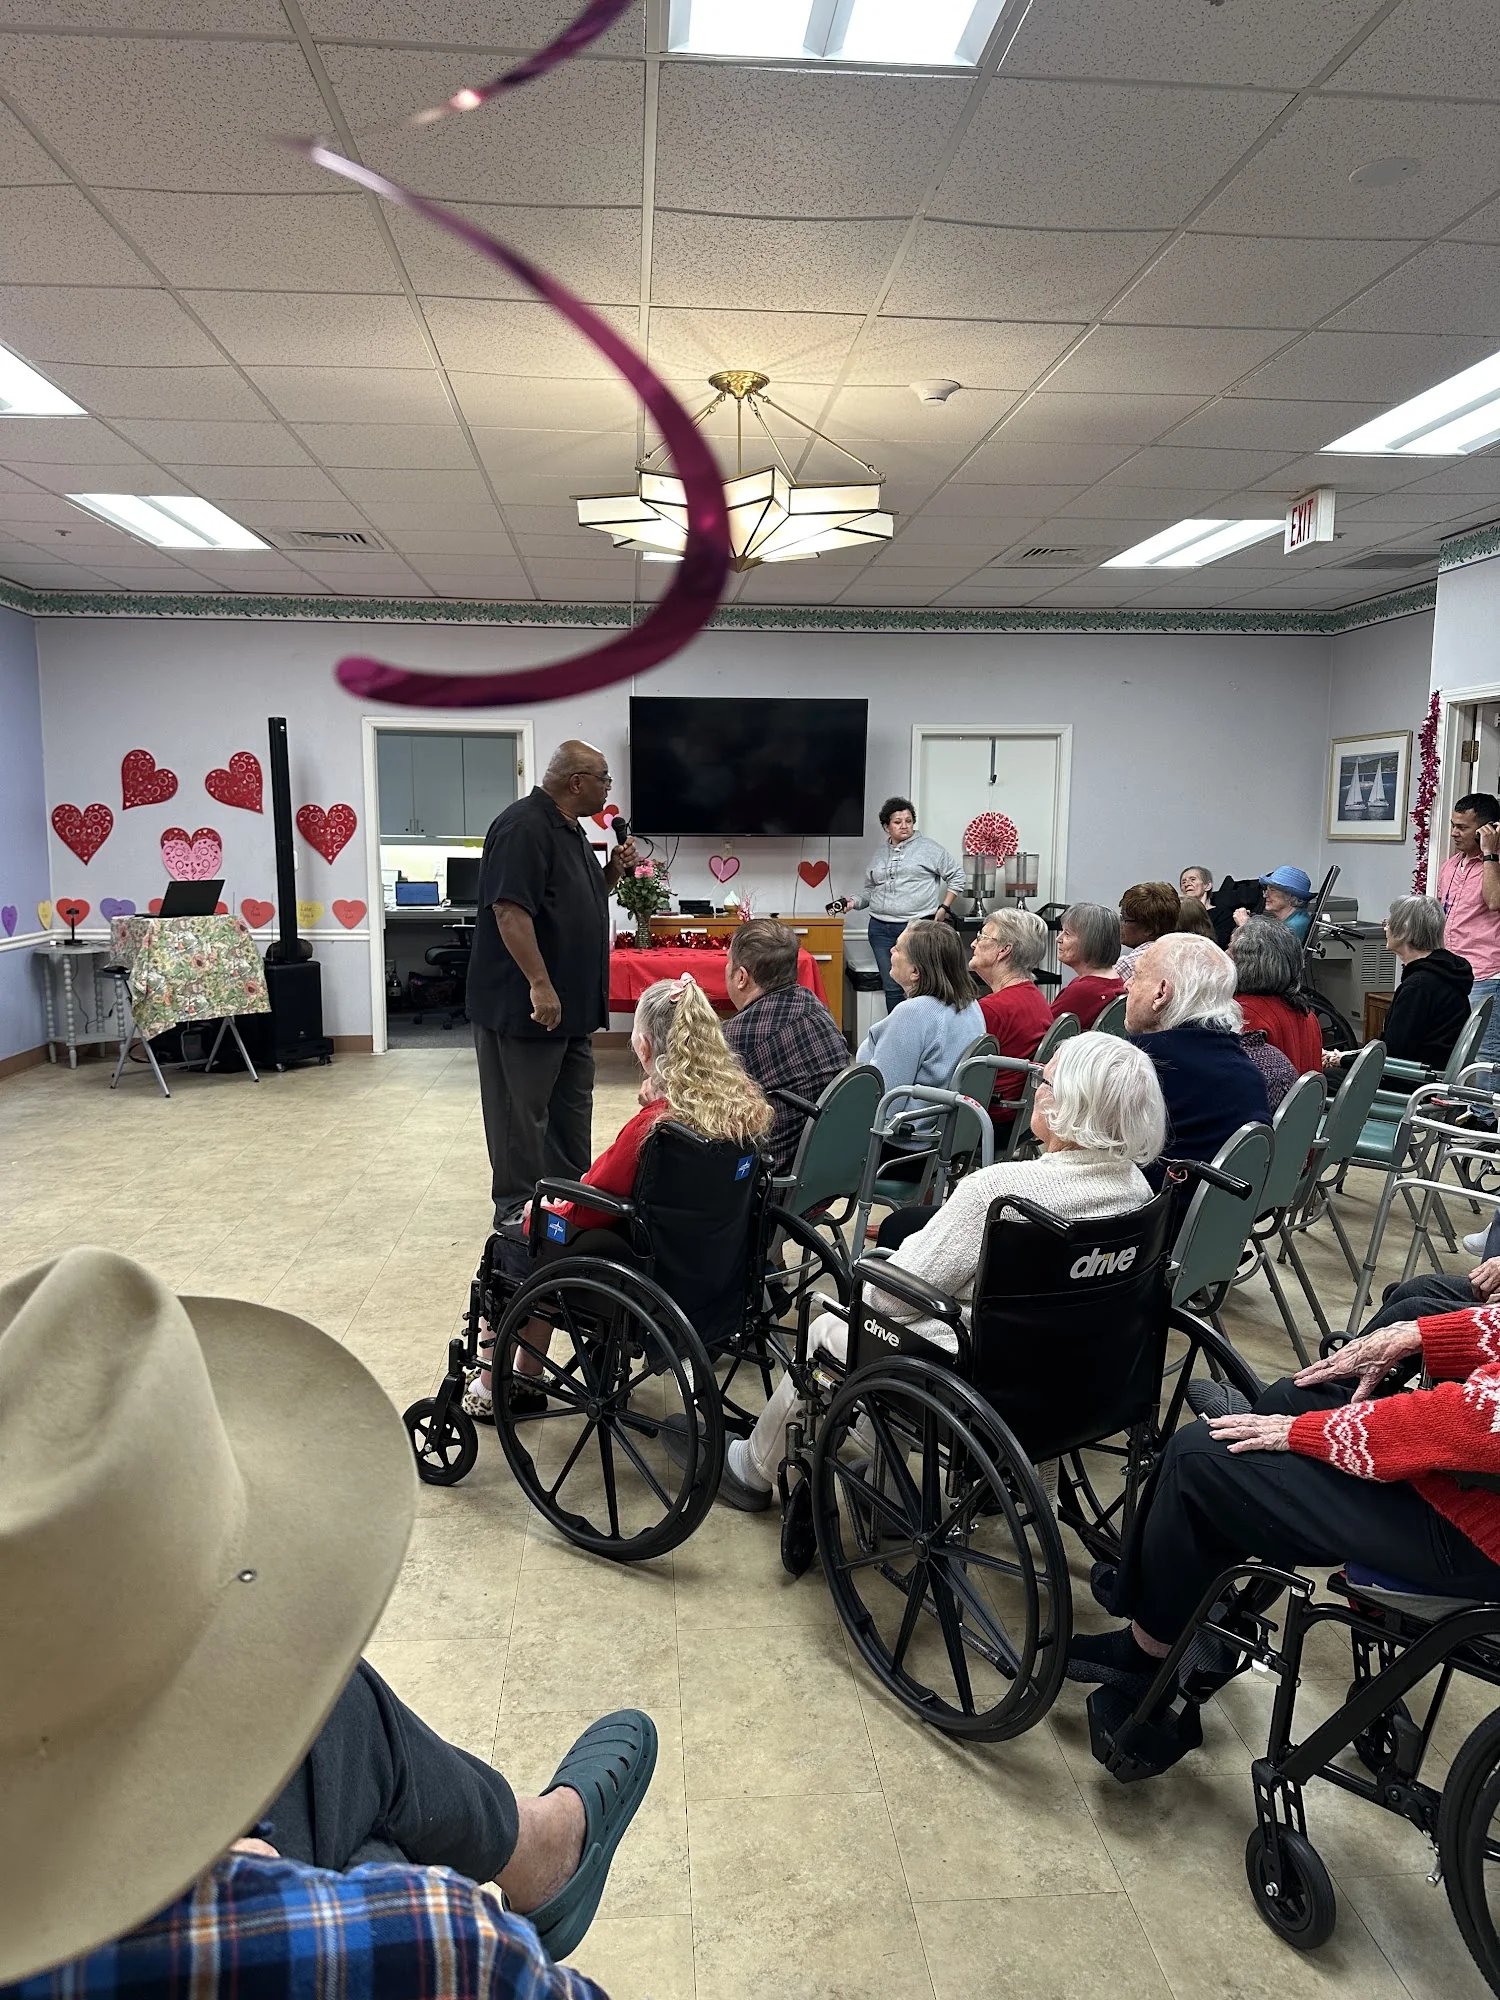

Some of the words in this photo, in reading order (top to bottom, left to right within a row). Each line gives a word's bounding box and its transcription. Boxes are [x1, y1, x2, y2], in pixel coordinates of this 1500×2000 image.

[1290, 498, 1314, 547] EXIT
[1070, 1247, 1137, 1279] drive
[863, 1318, 900, 1347] drive
